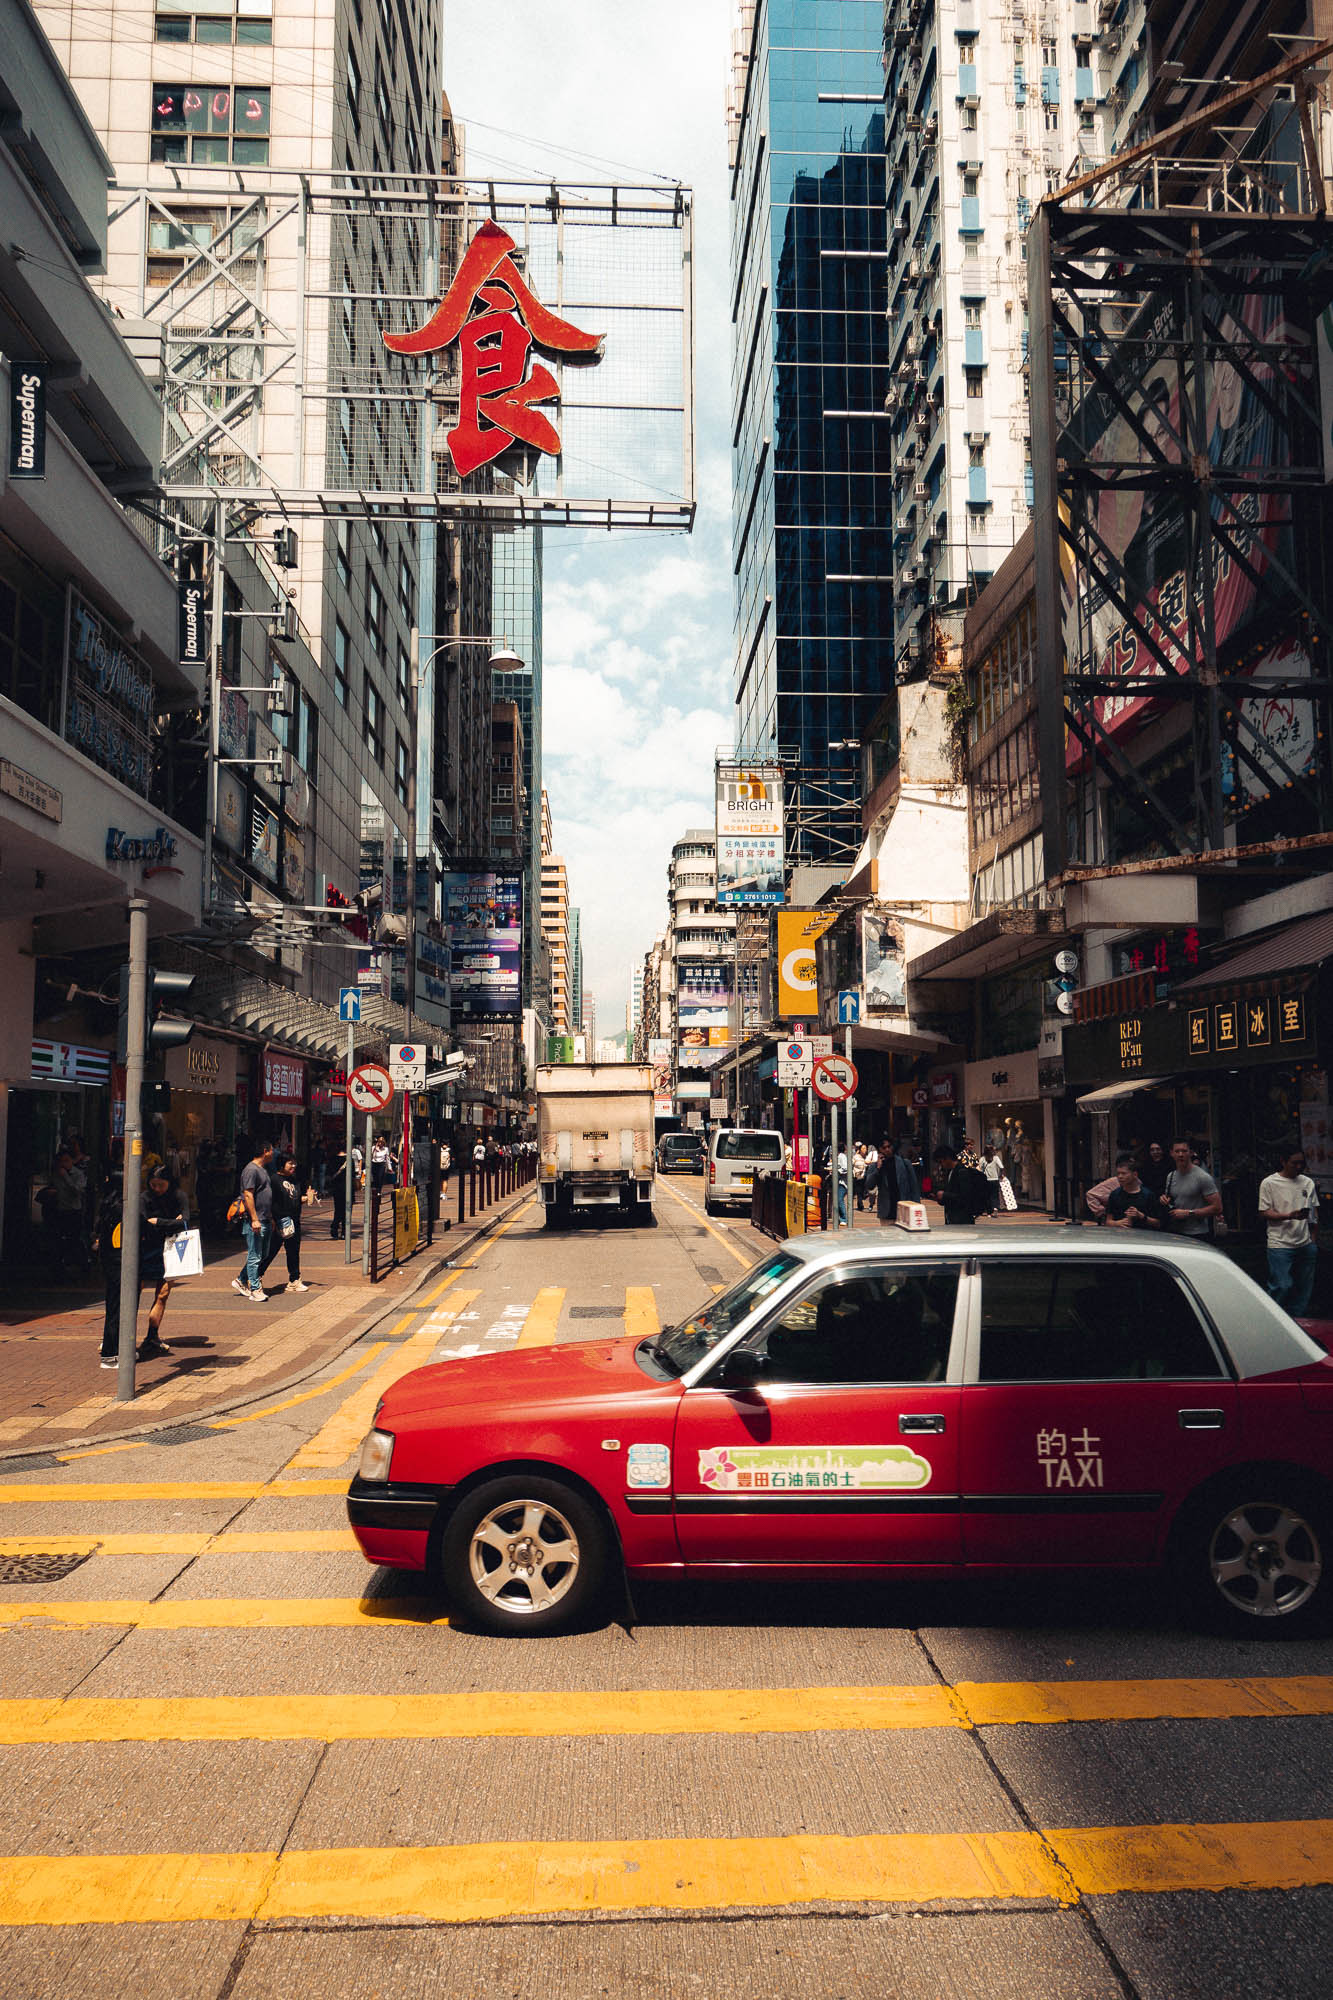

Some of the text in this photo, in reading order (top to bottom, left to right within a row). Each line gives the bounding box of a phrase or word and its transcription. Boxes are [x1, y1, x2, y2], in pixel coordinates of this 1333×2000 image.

[382, 217, 608, 479] 食
[16, 373, 41, 469] Superman
[182, 588, 201, 658] Superman
[728, 801, 775, 811] BRIGHT
[1120, 1020, 1142, 1040] RED
[1192, 996, 1301, 1045] 紅豆冰室
[1120, 1042, 1143, 1058] Bean
[412, 1066, 418, 1075] 7
[800, 1063, 806, 1072] 7
[412, 1080, 424, 1089] 12
[801, 1077, 812, 1086] 12
[1036, 1427, 1101, 1457] 的士
[1037, 1458, 1104, 1488] TAXI
